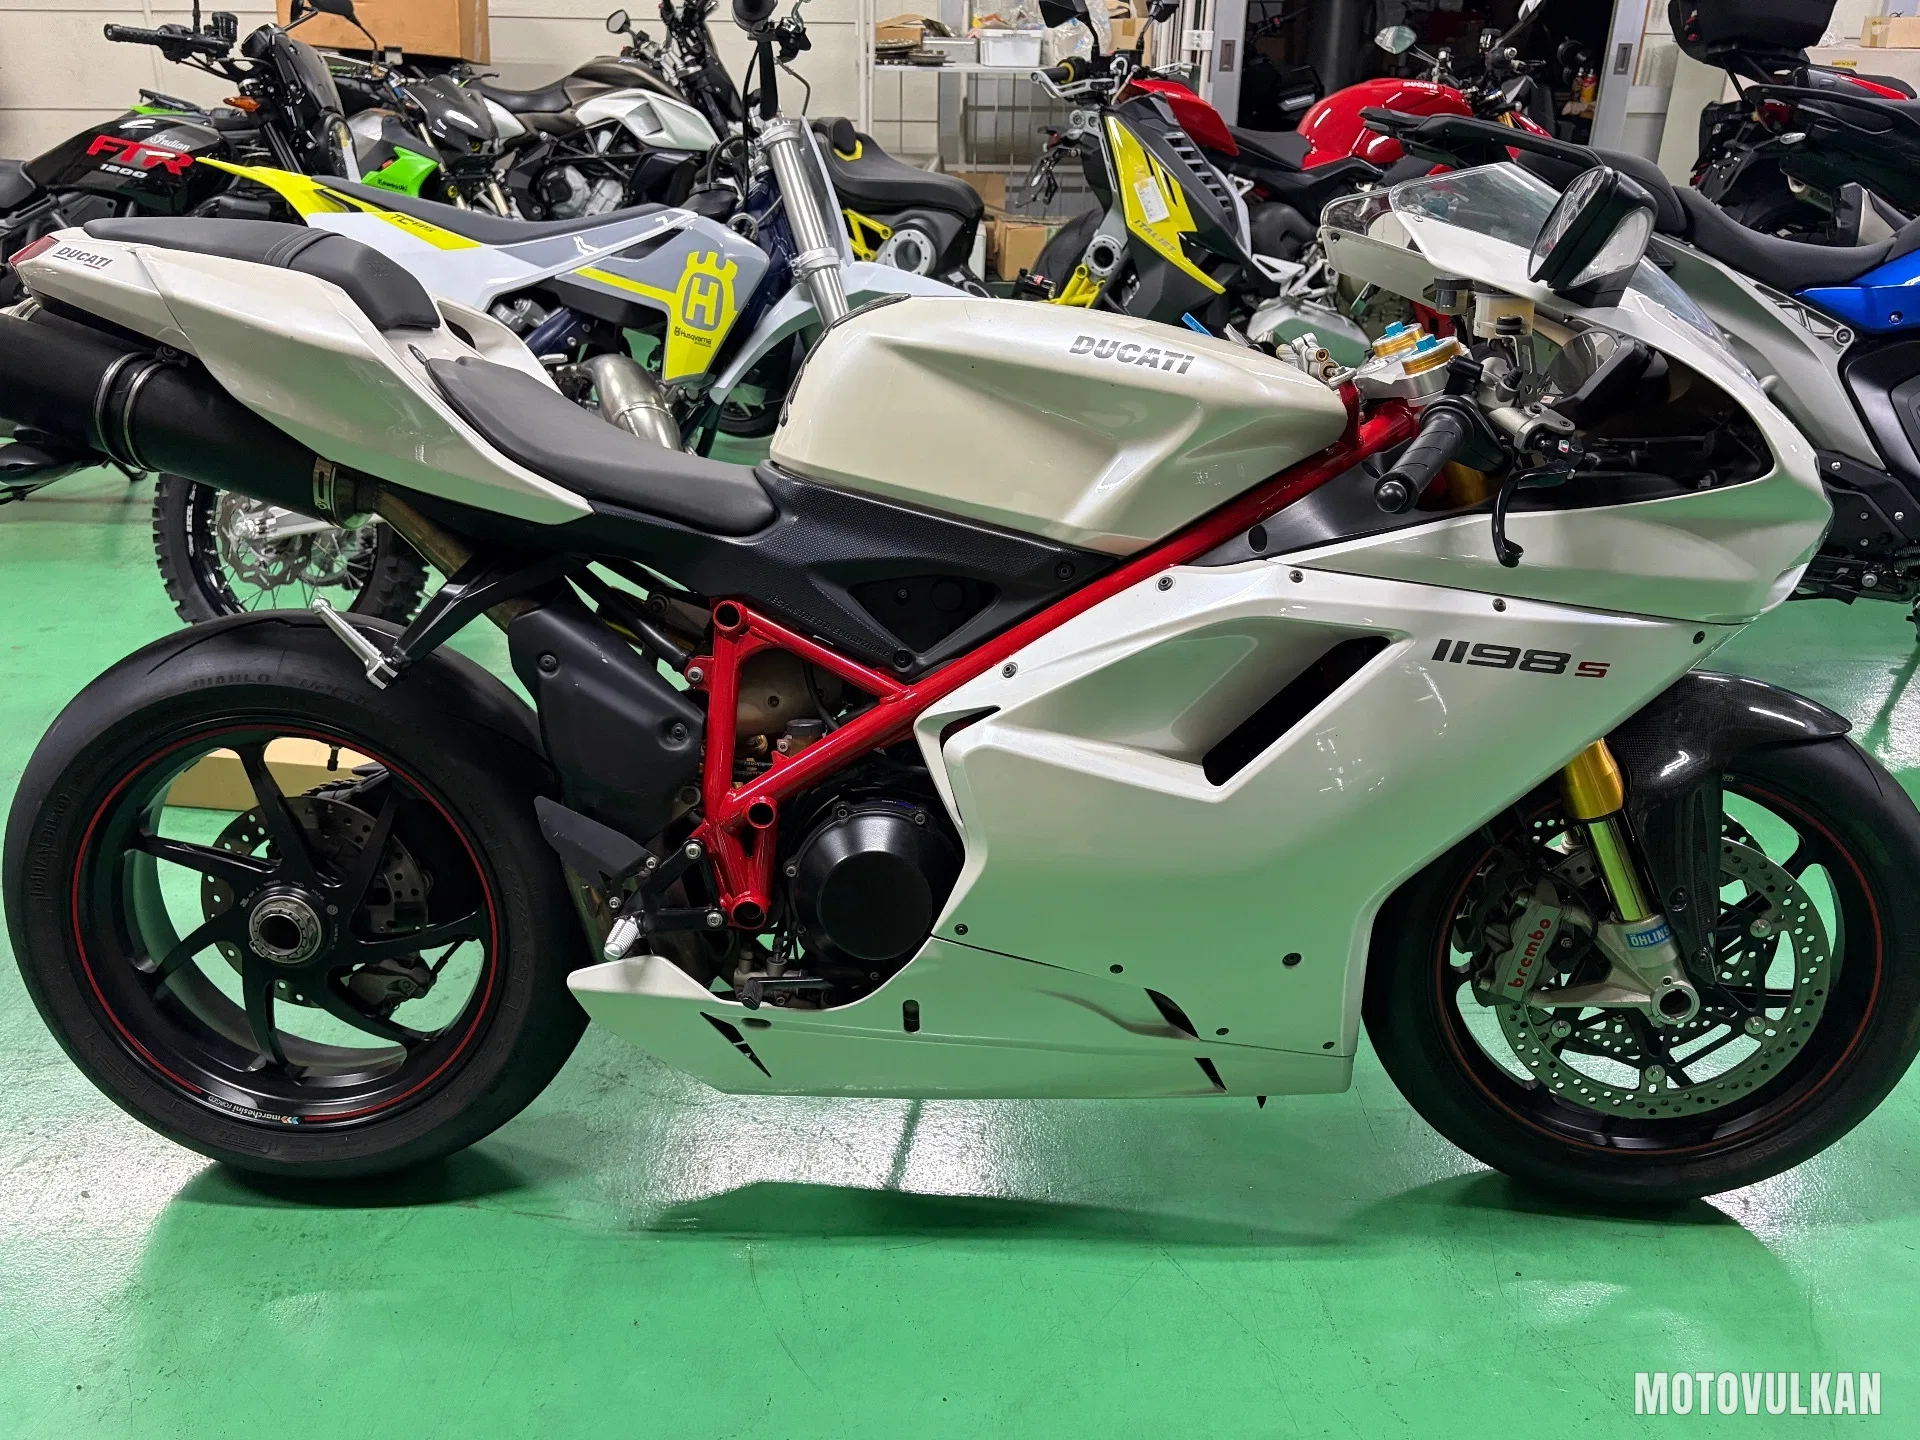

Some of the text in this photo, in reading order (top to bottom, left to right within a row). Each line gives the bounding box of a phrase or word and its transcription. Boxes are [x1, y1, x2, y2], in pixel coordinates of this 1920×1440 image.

[150, 134, 191, 151] Indian
[85, 134, 195, 176] FTR
[100, 163, 148, 179] 1200
[55, 246, 114, 267] DUCATI
[680, 330, 712, 345] Husqvarna
[1068, 335, 1196, 375] DUCATI
[1431, 638, 1572, 675] 1198
[1630, 927, 1671, 948] ÖHLINS
[1507, 918, 1552, 989] brembo
[207, 1094, 281, 1121] marchesini FORGED
